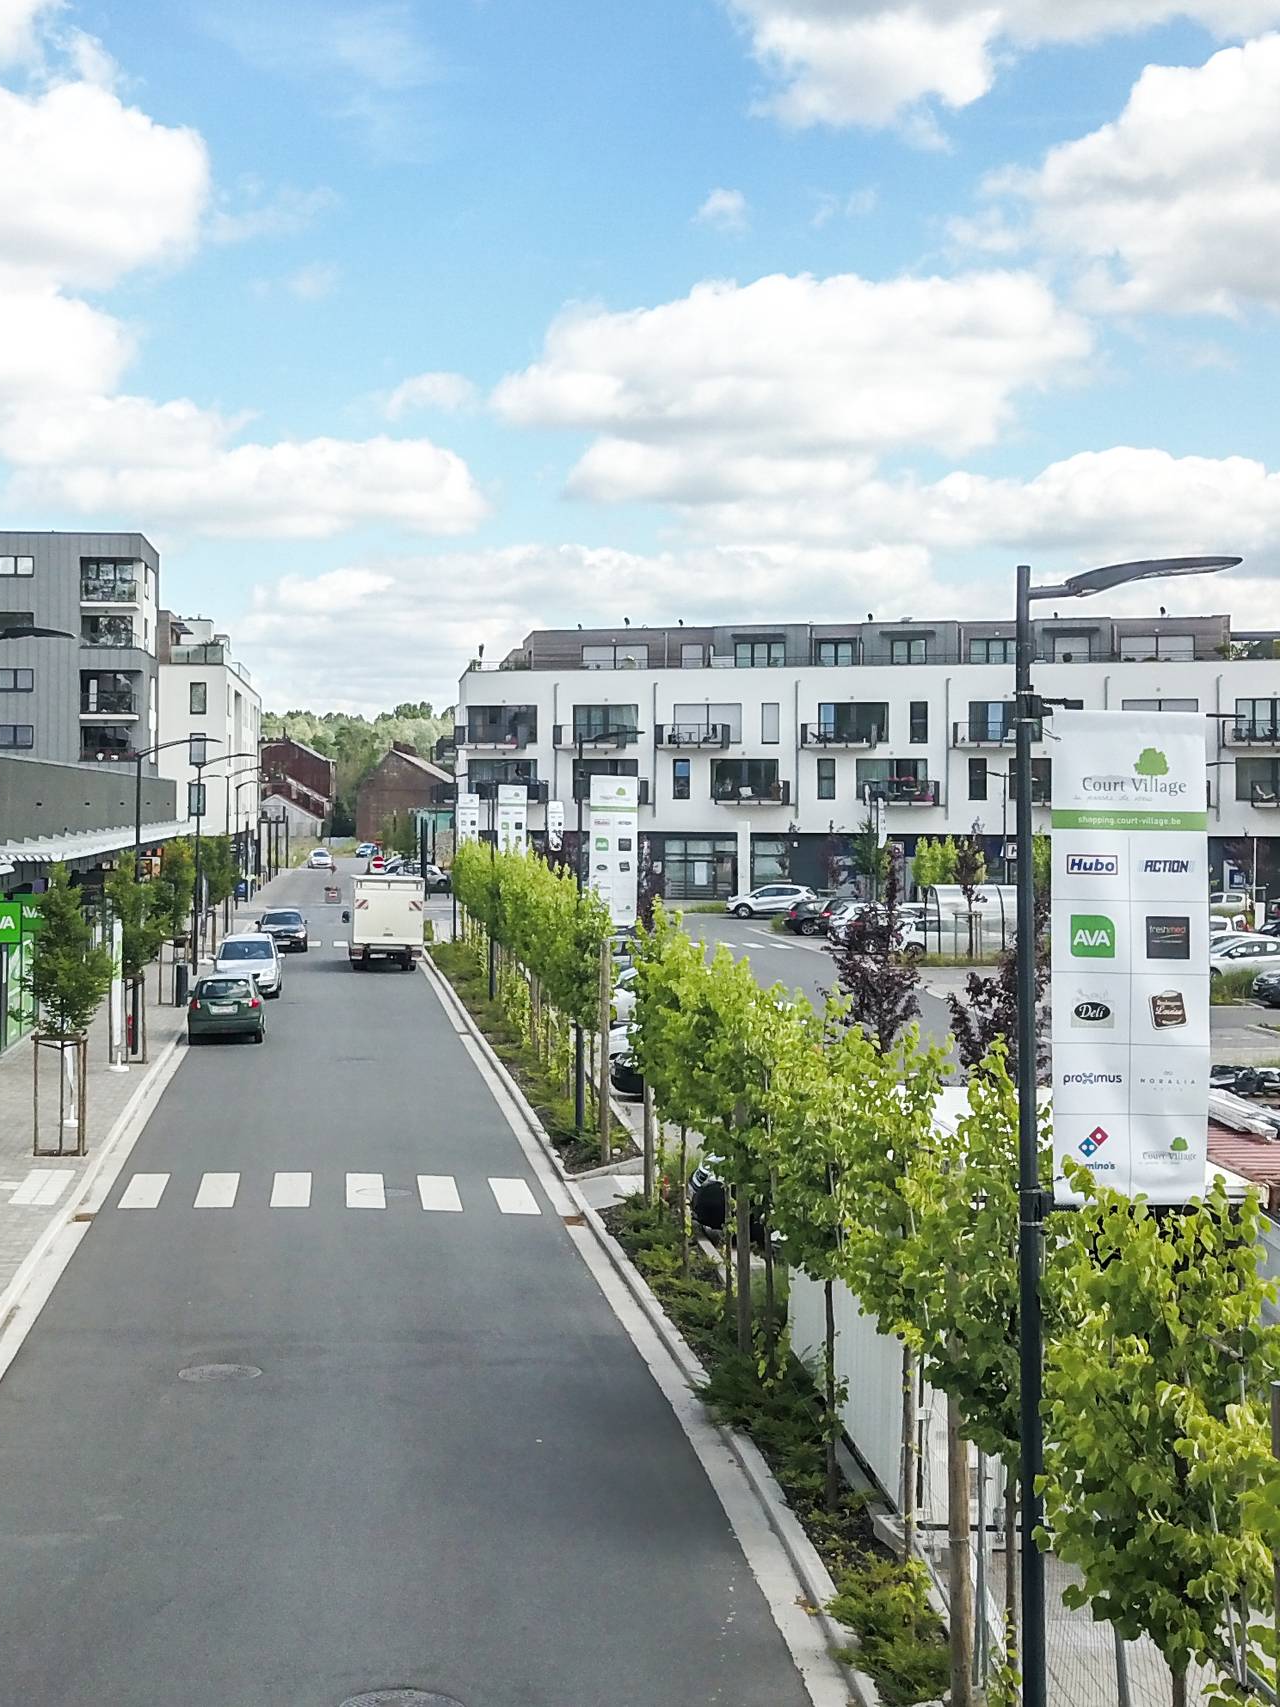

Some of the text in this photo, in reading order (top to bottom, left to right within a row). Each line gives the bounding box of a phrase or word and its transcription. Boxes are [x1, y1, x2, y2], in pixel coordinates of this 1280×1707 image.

[1082, 776, 1187, 796] Court Village
[1078, 815, 1181, 826] shopping.court-village.be
[1070, 858, 1115, 872] Hubo
[1144, 859, 1189, 873] ACTION
[1073, 928, 1111, 947] AVA
[1078, 1003, 1106, 1019] Deli
[1063, 1072, 1123, 1086] proximus
[1074, 1160, 1116, 1171] mino's
